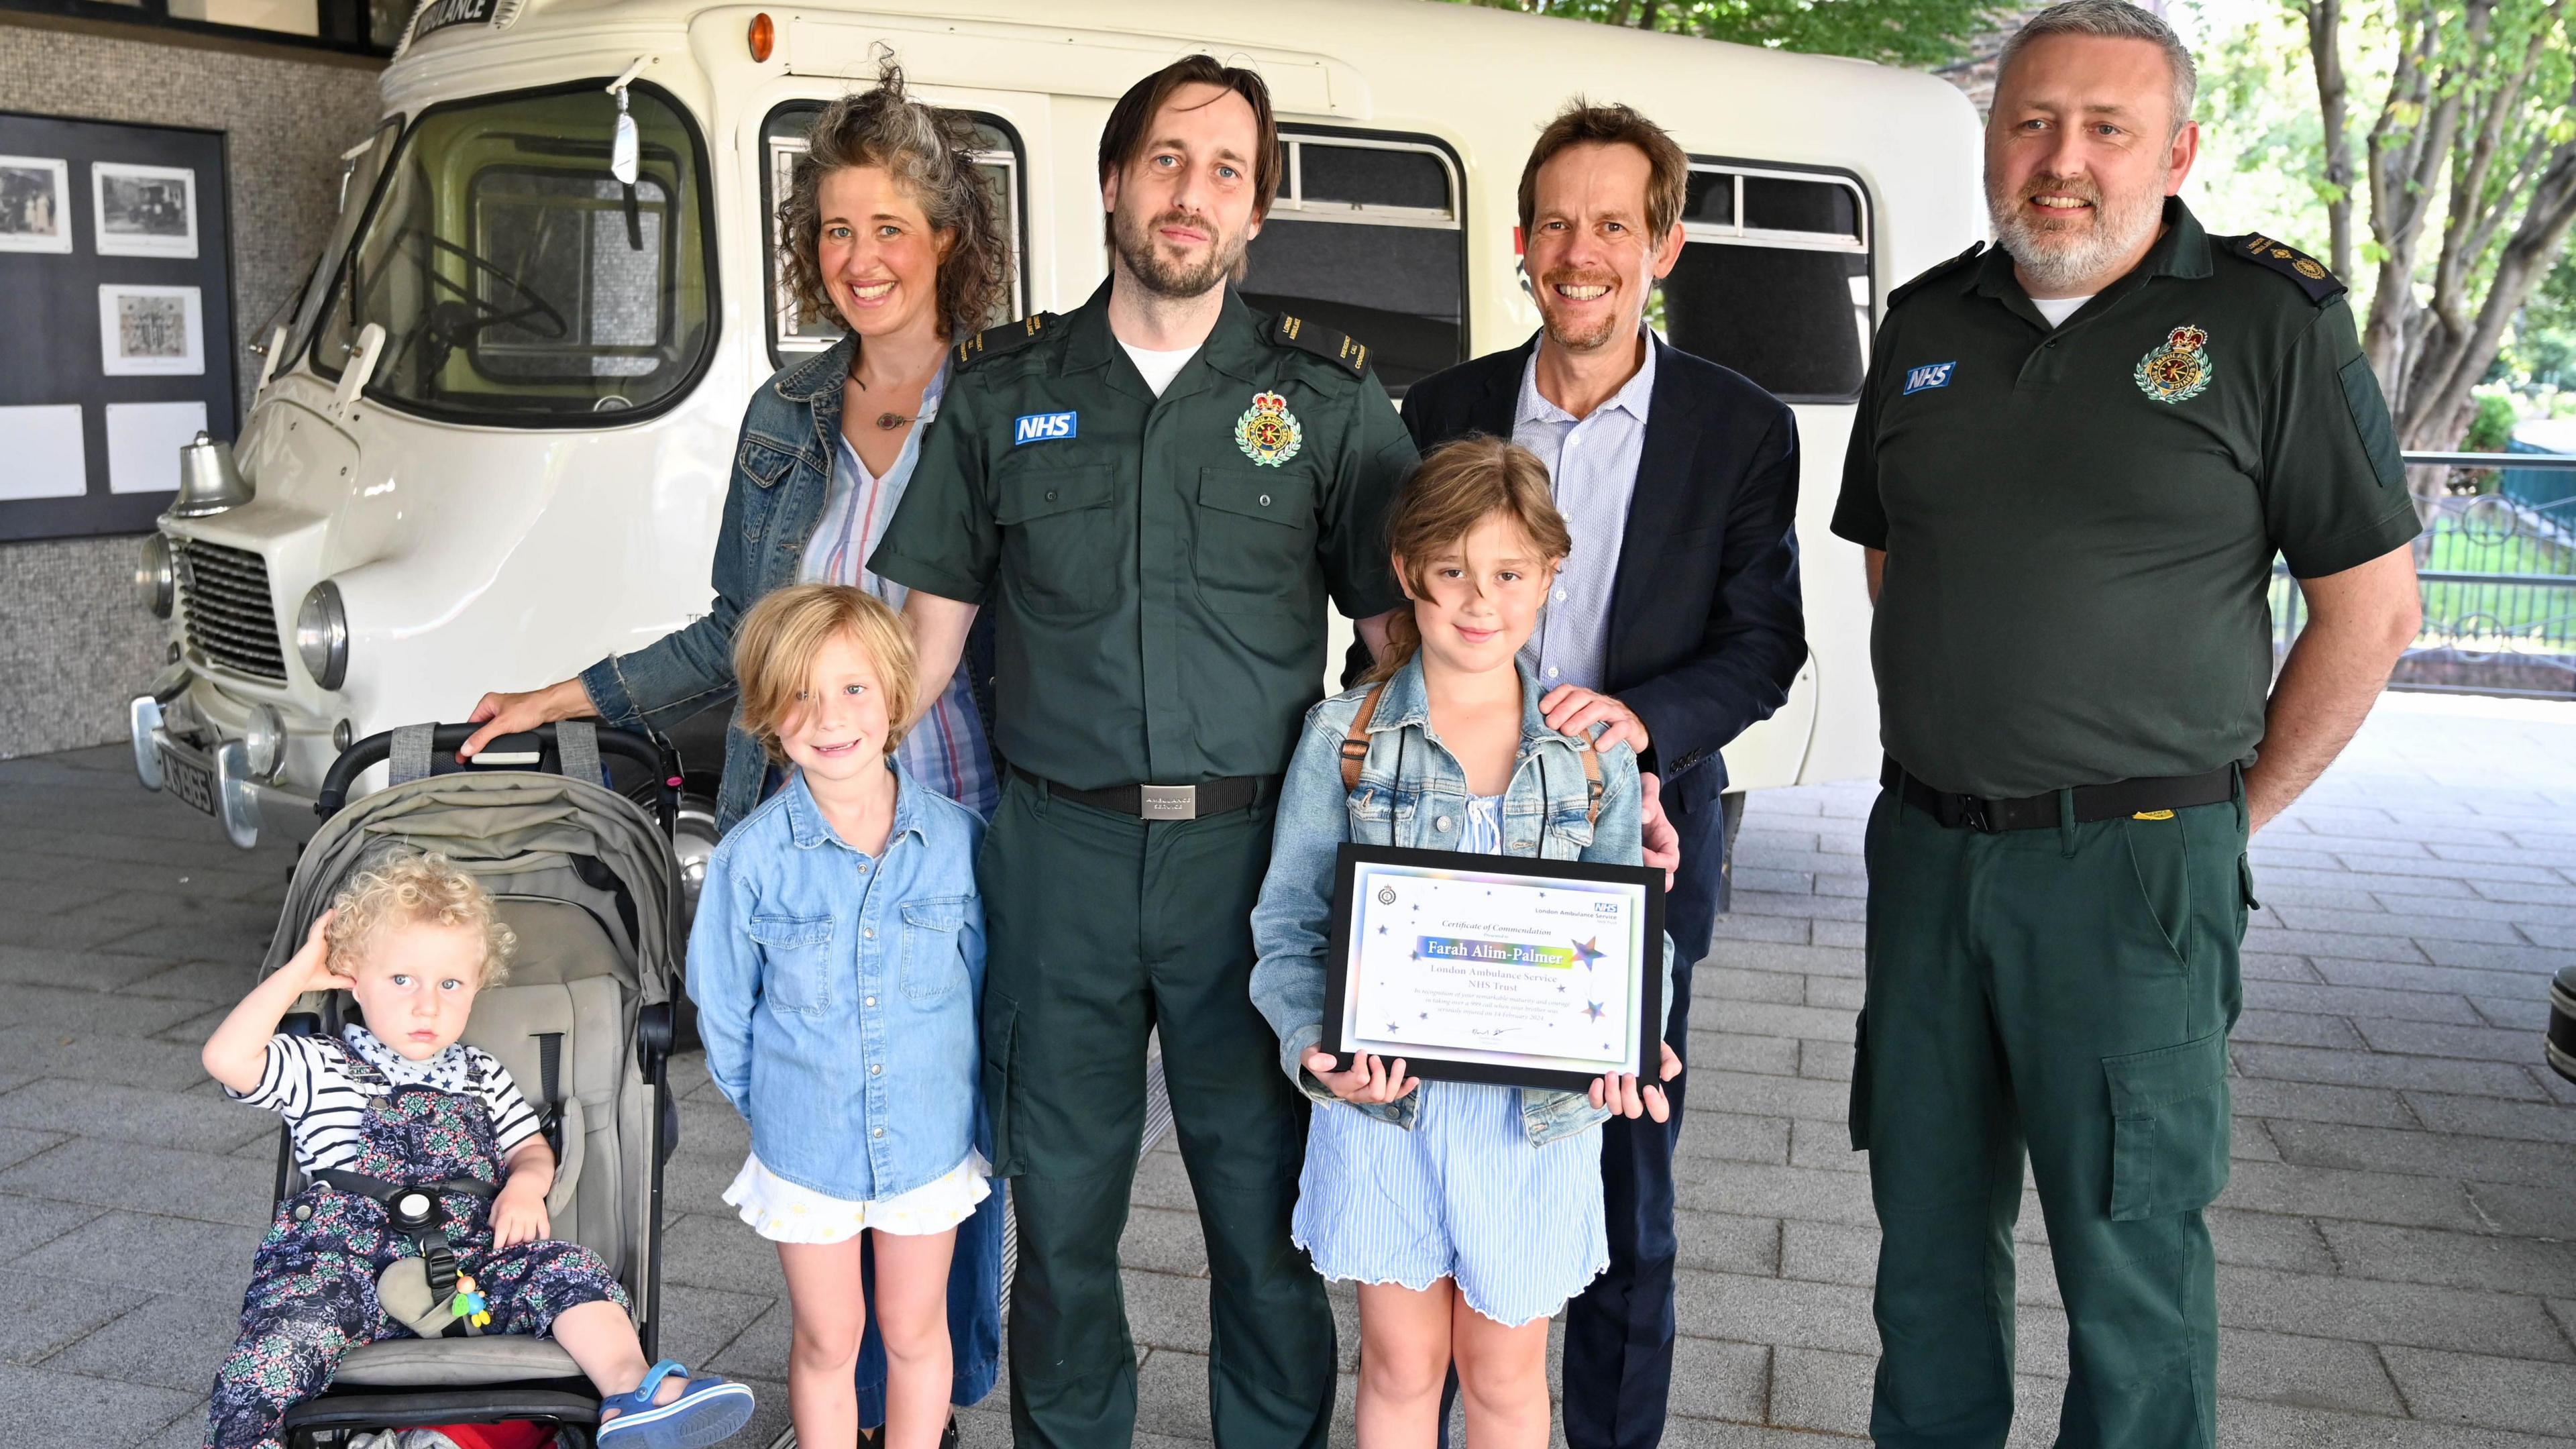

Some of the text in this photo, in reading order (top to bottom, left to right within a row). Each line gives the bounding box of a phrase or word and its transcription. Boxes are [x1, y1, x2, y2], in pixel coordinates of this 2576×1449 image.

[414, 0, 484, 35] ULANCE
[2153, 352, 2196, 370] AMBULANCE
[1906, 365, 1951, 391] NHS
[1017, 414, 1071, 441] NHS
[1560, 910, 1594, 918] Ambulance
[1595, 902, 1617, 912] NHS
[1442, 920, 1552, 936] Certificate of Commendation
[1428, 941, 1563, 965] Farah Alim-Palmer
[1431, 965, 1558, 983] London Ambulance Service
[1468, 980, 1517, 991] NHS Trust
